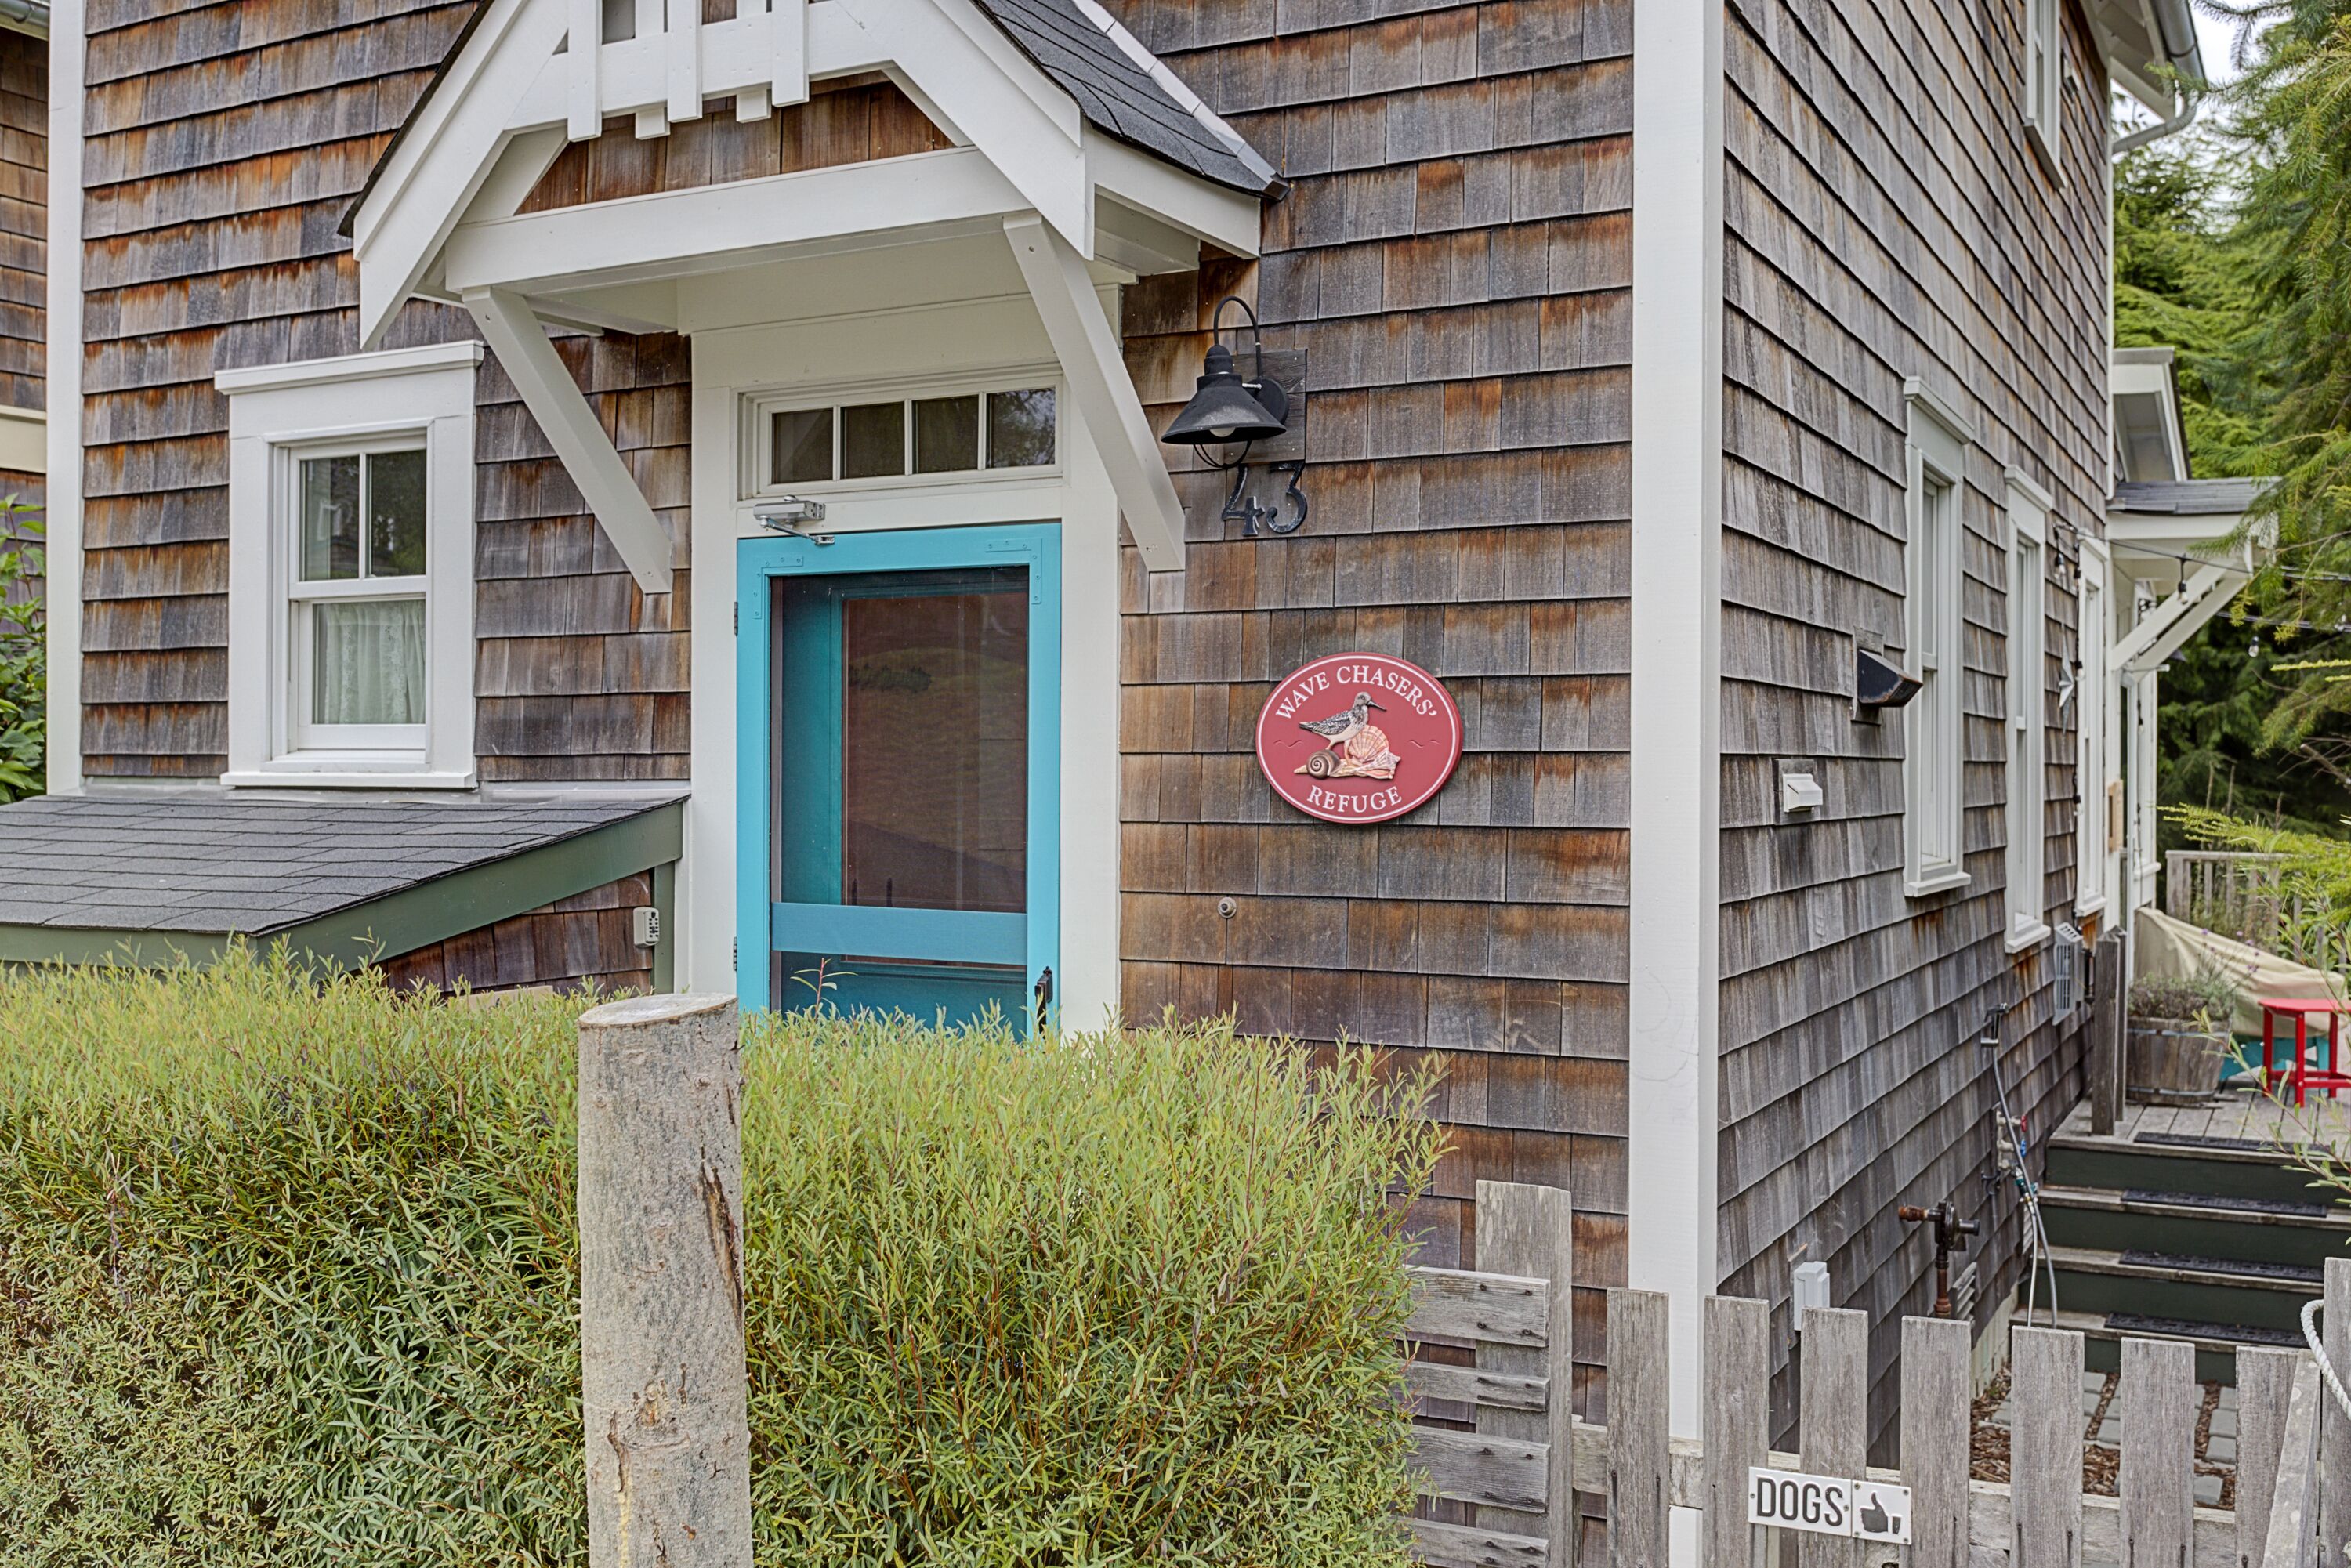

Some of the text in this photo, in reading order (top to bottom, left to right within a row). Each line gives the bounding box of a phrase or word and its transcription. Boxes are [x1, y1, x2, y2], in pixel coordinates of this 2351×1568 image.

[1221, 459, 1308, 536] 43
[1275, 671, 1330, 719] WAVE
[1307, 784, 1402, 813] REFUGE
[1757, 1477, 1843, 1526] DOGS
